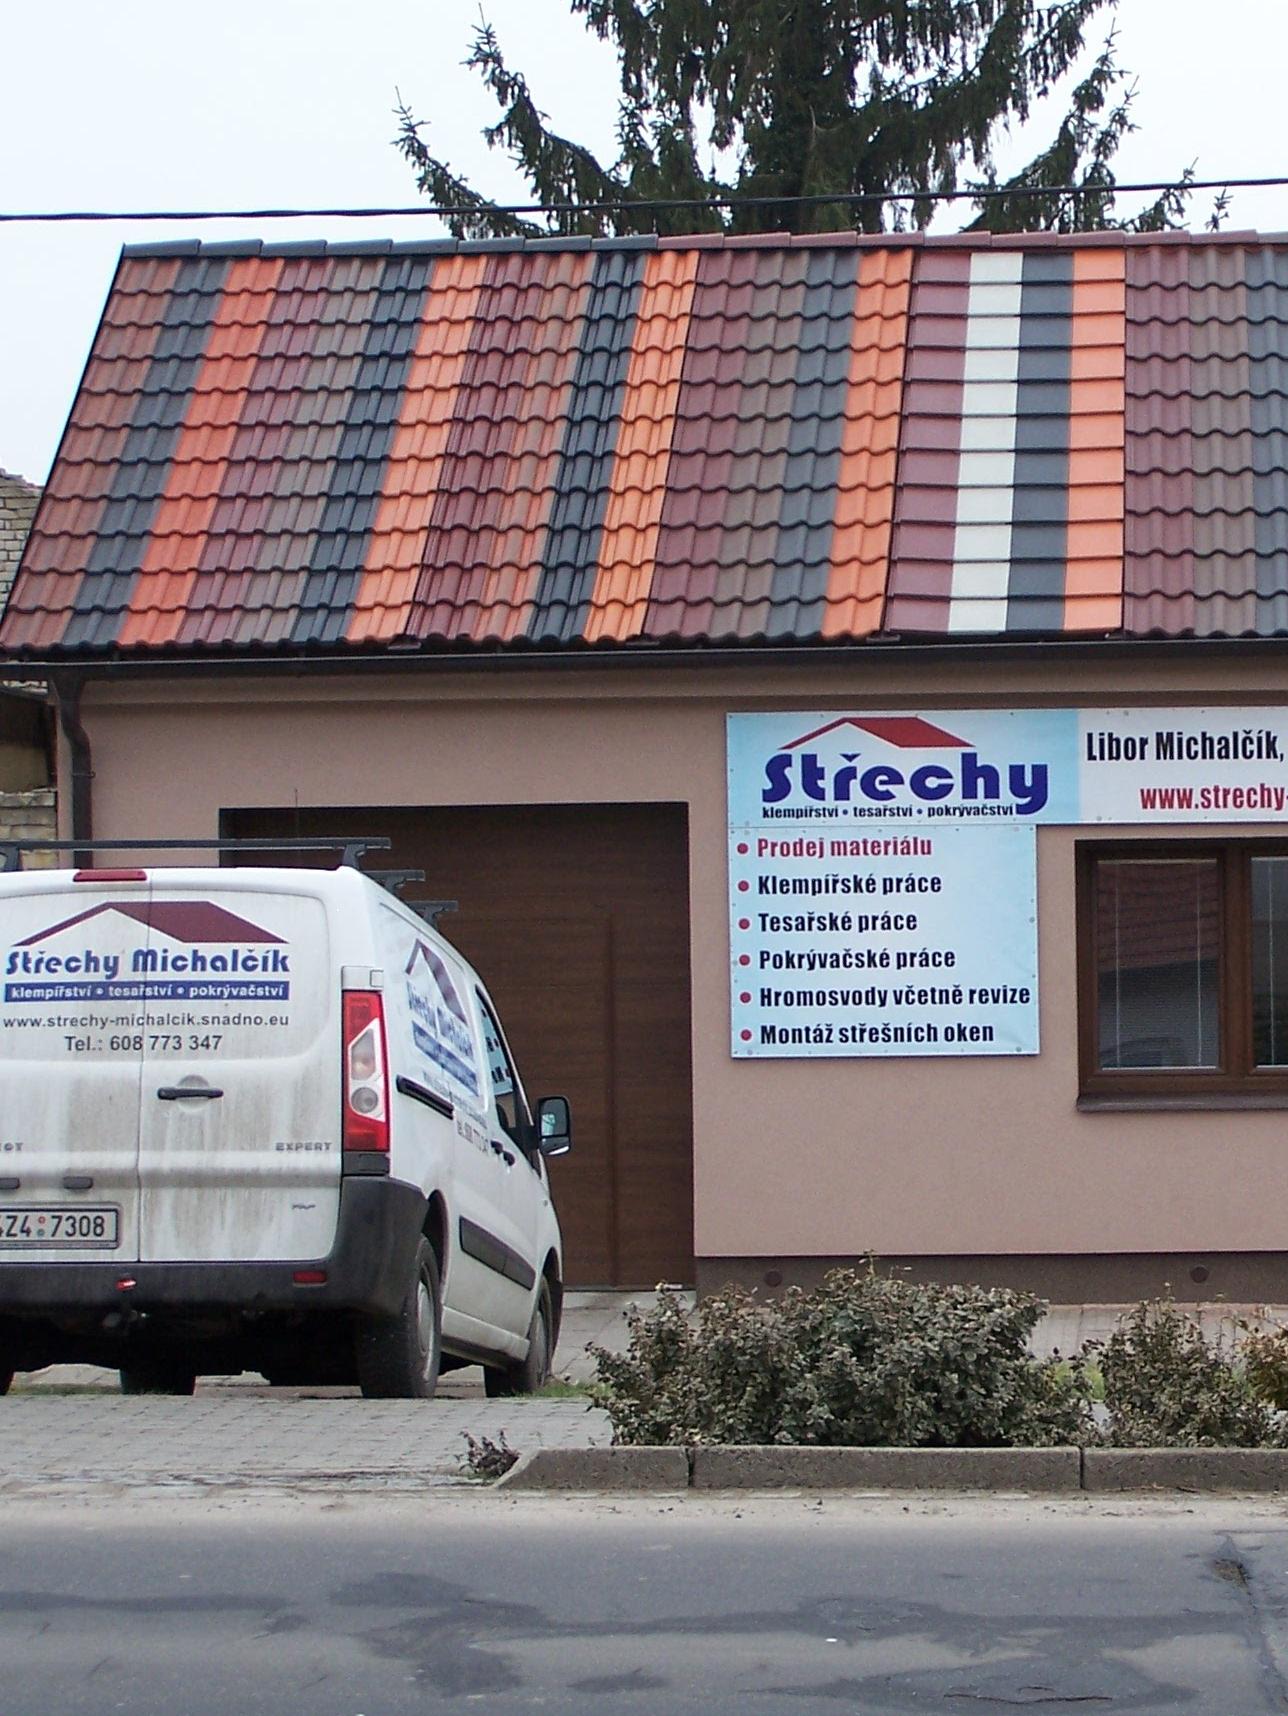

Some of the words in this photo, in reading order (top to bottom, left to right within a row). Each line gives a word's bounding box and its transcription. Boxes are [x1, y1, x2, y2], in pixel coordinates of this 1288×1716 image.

[1086, 731, 1148, 761] Libor
[1155, 729, 1284, 763] Michalčík,
[762, 752, 1049, 815] Střechy
[762, 804, 839, 819] klempířství
[853, 804, 913, 818] tesařství
[927, 802, 1014, 818] pokrývačství
[757, 838, 824, 858] Prodej
[830, 836, 932, 857] materiálu
[758, 873, 876, 896] Klempířské
[882, 874, 942, 896] práce
[759, 911, 852, 932] Tesařské
[858, 911, 918, 933] práce
[6, 950, 120, 980] Střechy
[132, 948, 290, 973] Michalčík
[759, 948, 890, 971] Pokrývačské
[896, 948, 956, 970] práce
[11, 984, 91, 999] klempířství
[109, 983, 172, 998] tesařství
[189, 983, 284, 998] pokrývačství
[760, 987, 887, 1008] Hromosvody
[892, 985, 963, 1005] včetně
[969, 985, 1031, 1004] revize
[3, 1012, 289, 1030] www.strechy-michalcik.snadno.eu
[64, 1036, 103, 1051] Tel.:
[110, 1035, 143, 1051] 608
[149, 1035, 182, 1050] 773
[188, 1035, 222, 1050] 347
[760, 1023, 833, 1044] Montáž
[839, 1022, 938, 1043] střešních
[944, 1023, 994, 1042] oken
[275, 1142, 332, 1151] EXPERT
[51, 1215, 105, 1237] 7308
